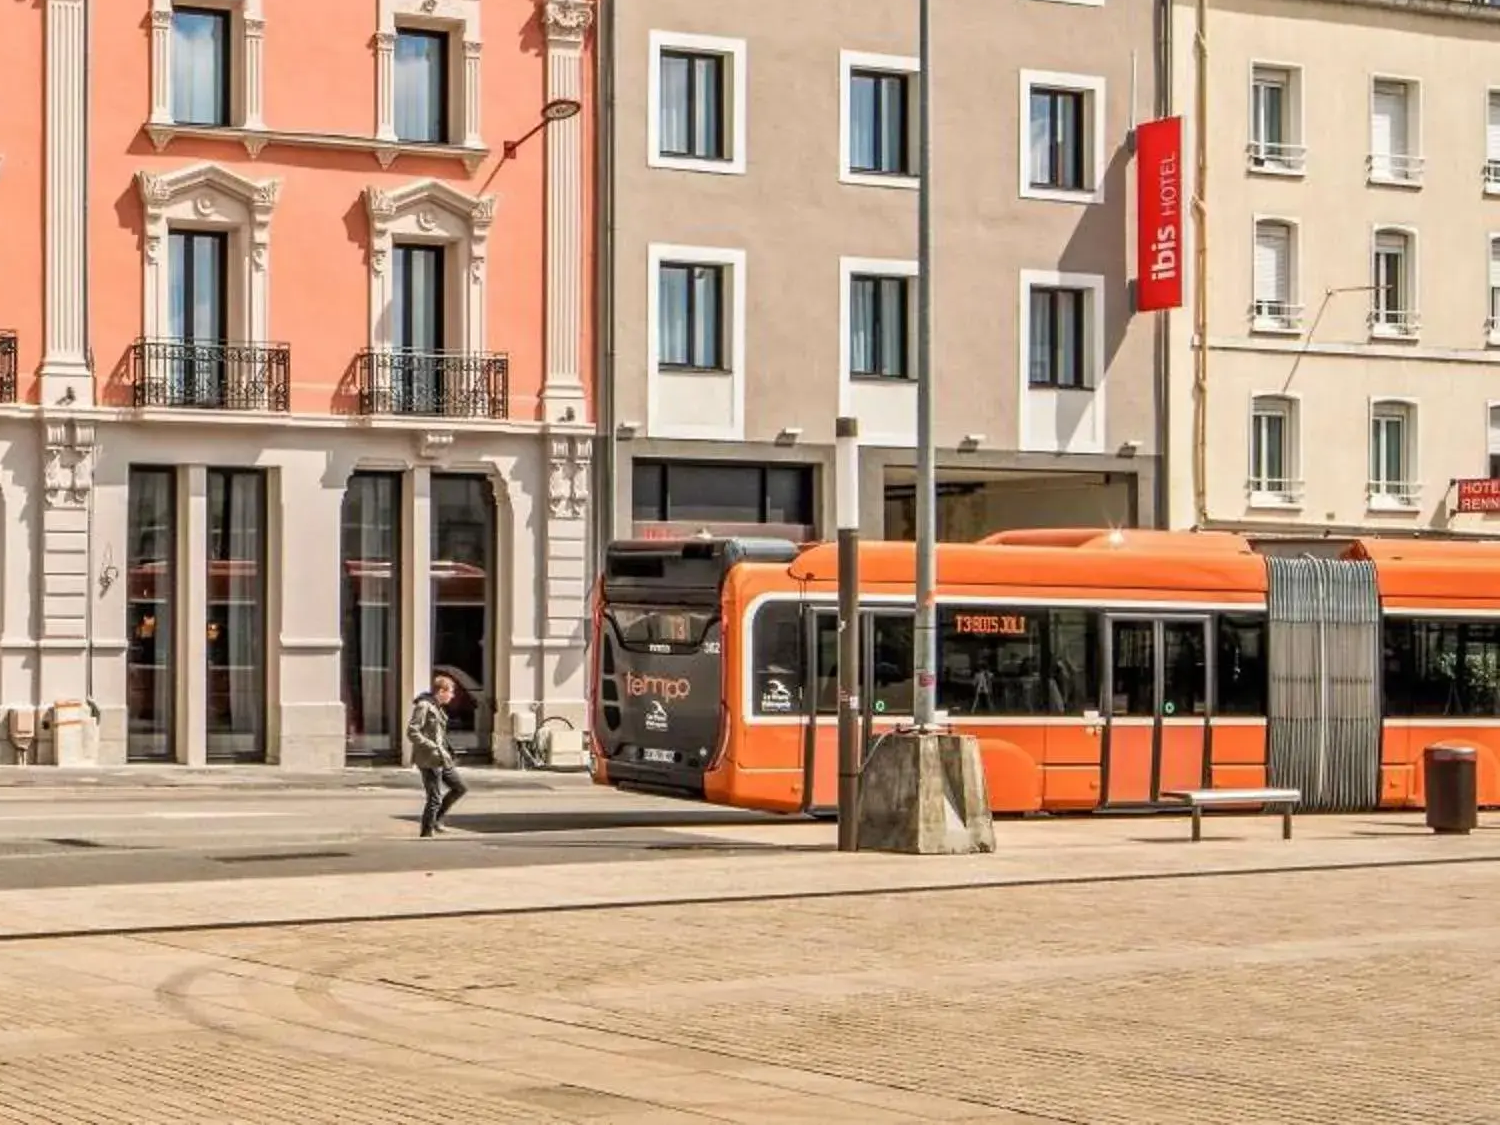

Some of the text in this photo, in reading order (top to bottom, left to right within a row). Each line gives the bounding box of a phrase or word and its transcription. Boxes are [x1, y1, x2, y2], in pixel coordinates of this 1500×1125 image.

[1151, 151, 1177, 280] ibis HOTEL
[625, 670, 691, 703] tempo
